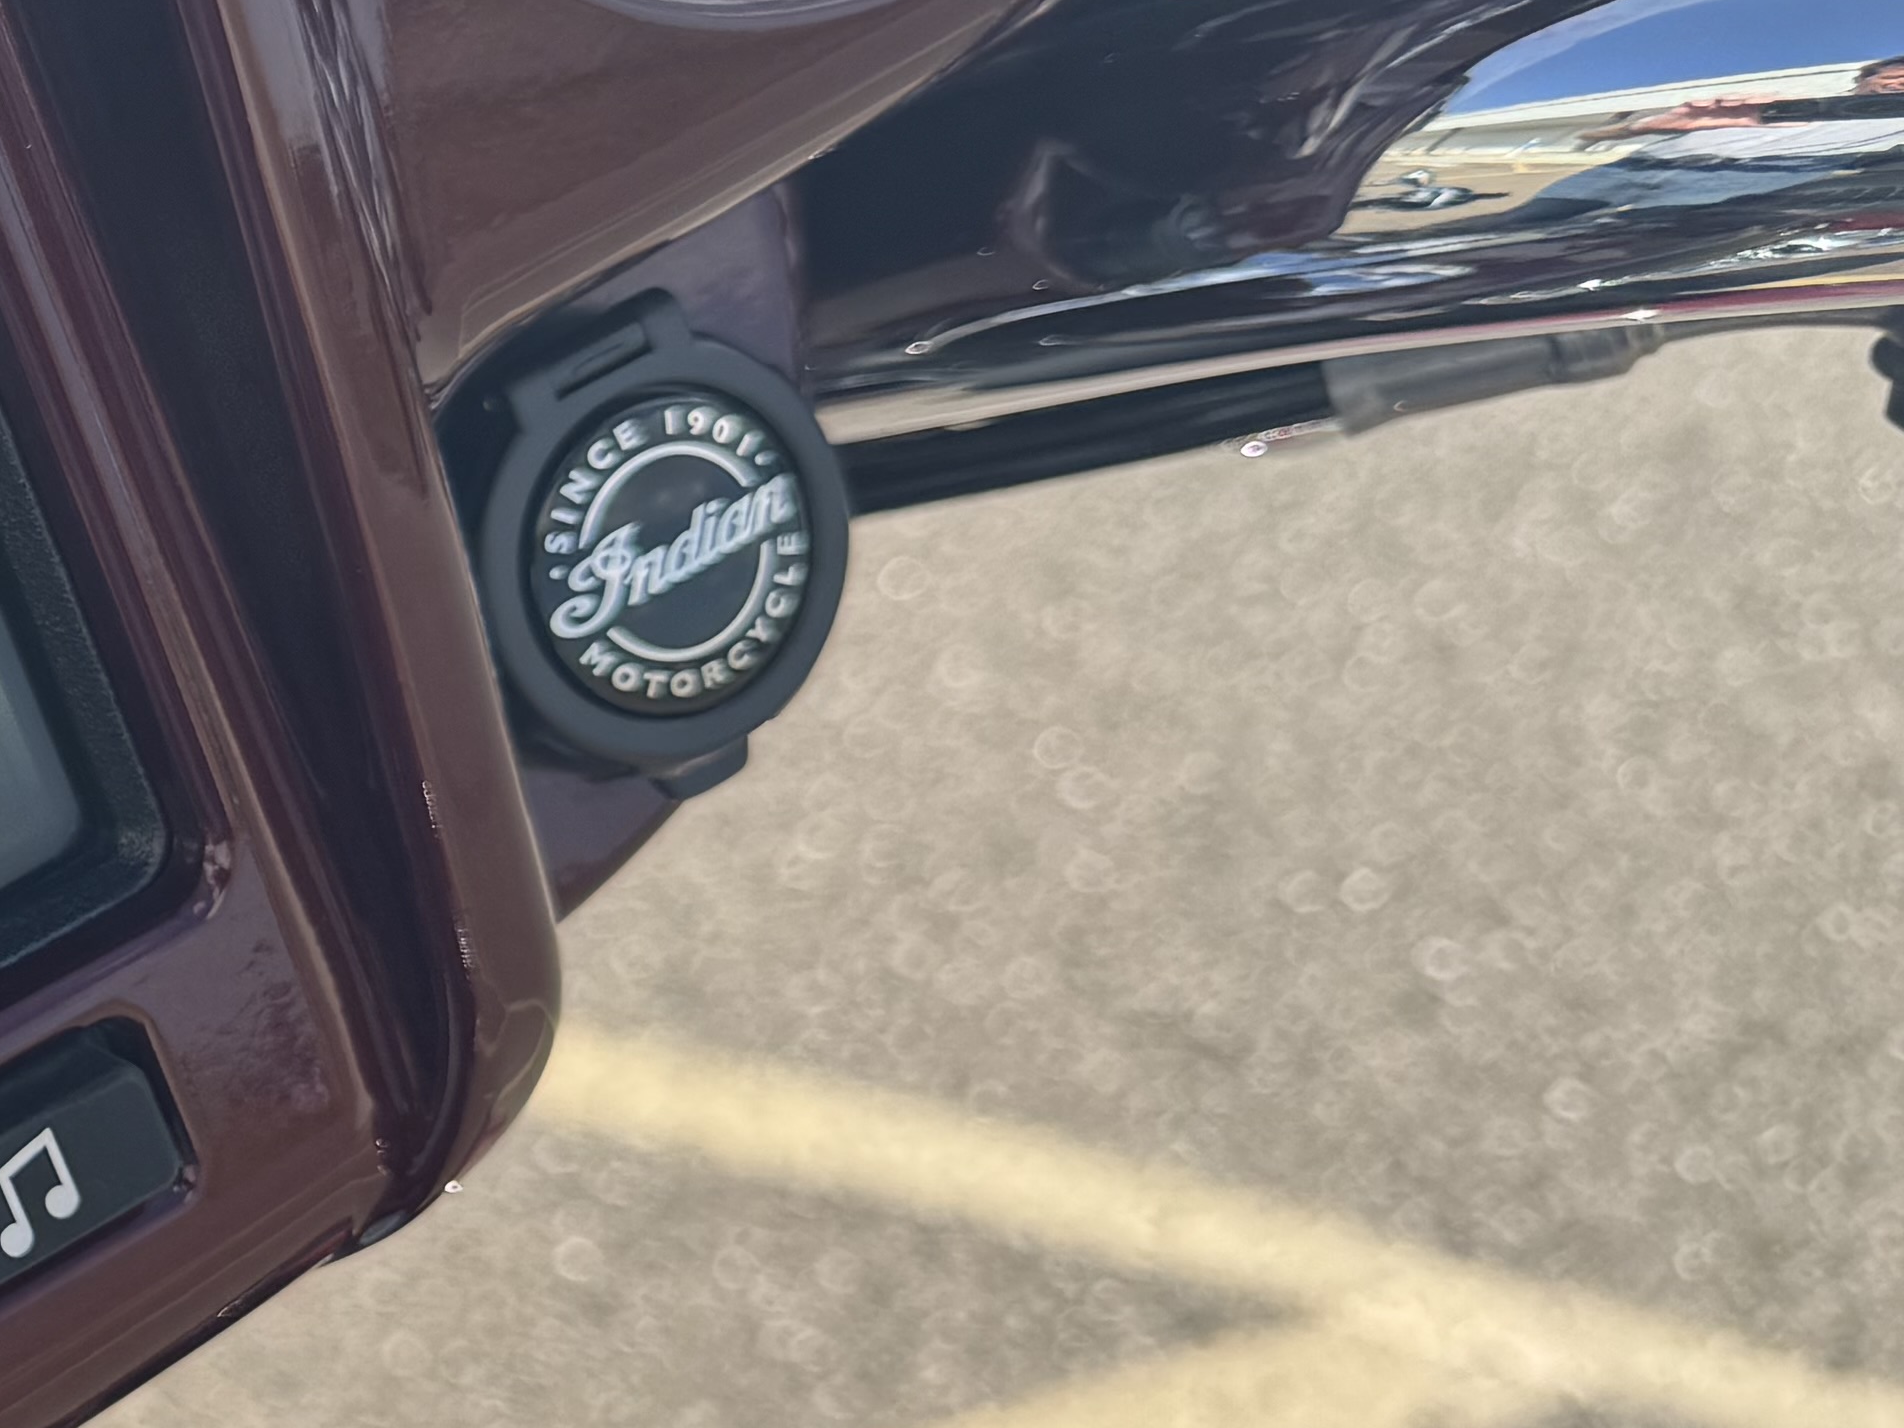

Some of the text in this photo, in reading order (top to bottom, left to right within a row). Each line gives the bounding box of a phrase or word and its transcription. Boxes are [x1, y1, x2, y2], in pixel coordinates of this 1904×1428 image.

[544, 419, 648, 554] SINCE
[550, 474, 798, 638] Indian
[579, 529, 809, 698] MOTORCYCLE
